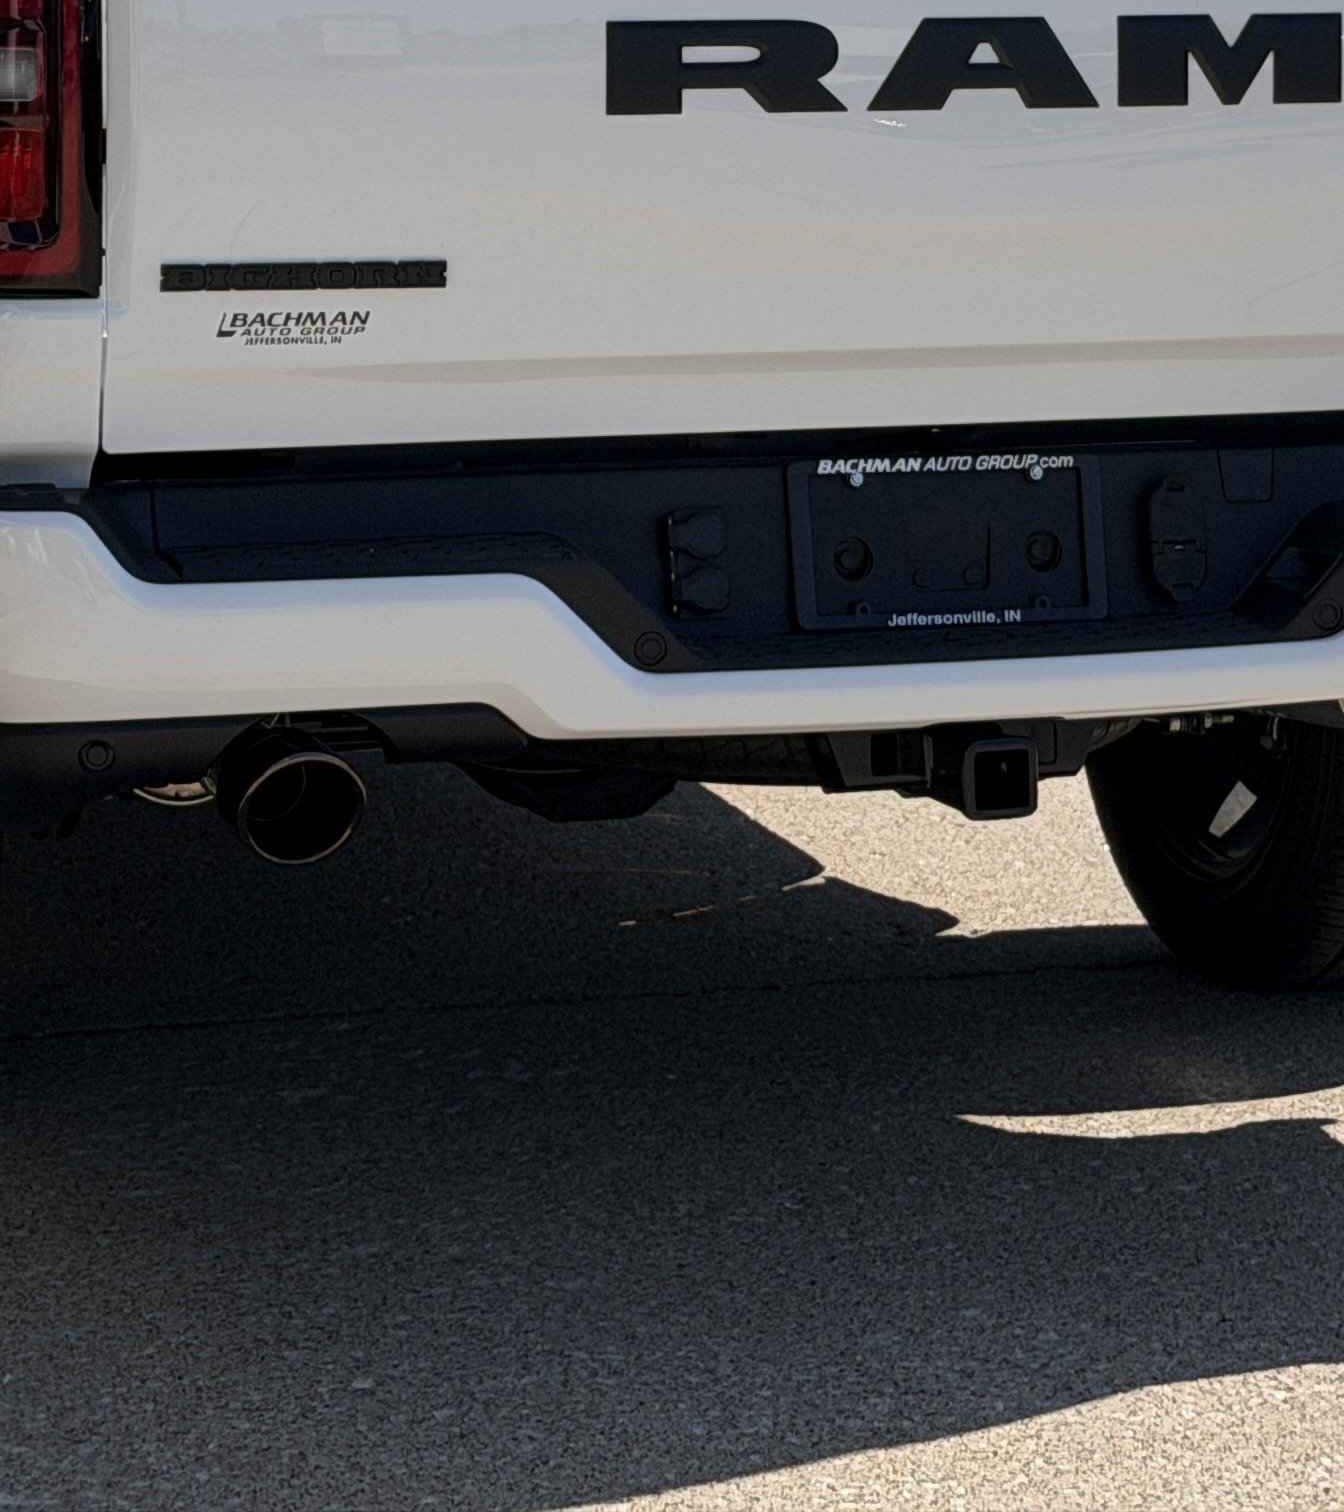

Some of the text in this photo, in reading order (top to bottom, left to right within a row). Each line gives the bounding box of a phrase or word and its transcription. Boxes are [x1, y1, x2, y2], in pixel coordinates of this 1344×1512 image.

[606, 13, 1343, 115] RAM
[229, 310, 371, 328] BACHMAN
[240, 326, 366, 337] AUTO GROUP
[817, 457, 922, 475] BACHMAN
[923, 455, 973, 472] AUTO
[887, 609, 1021, 627] Jeffersonville, IN
